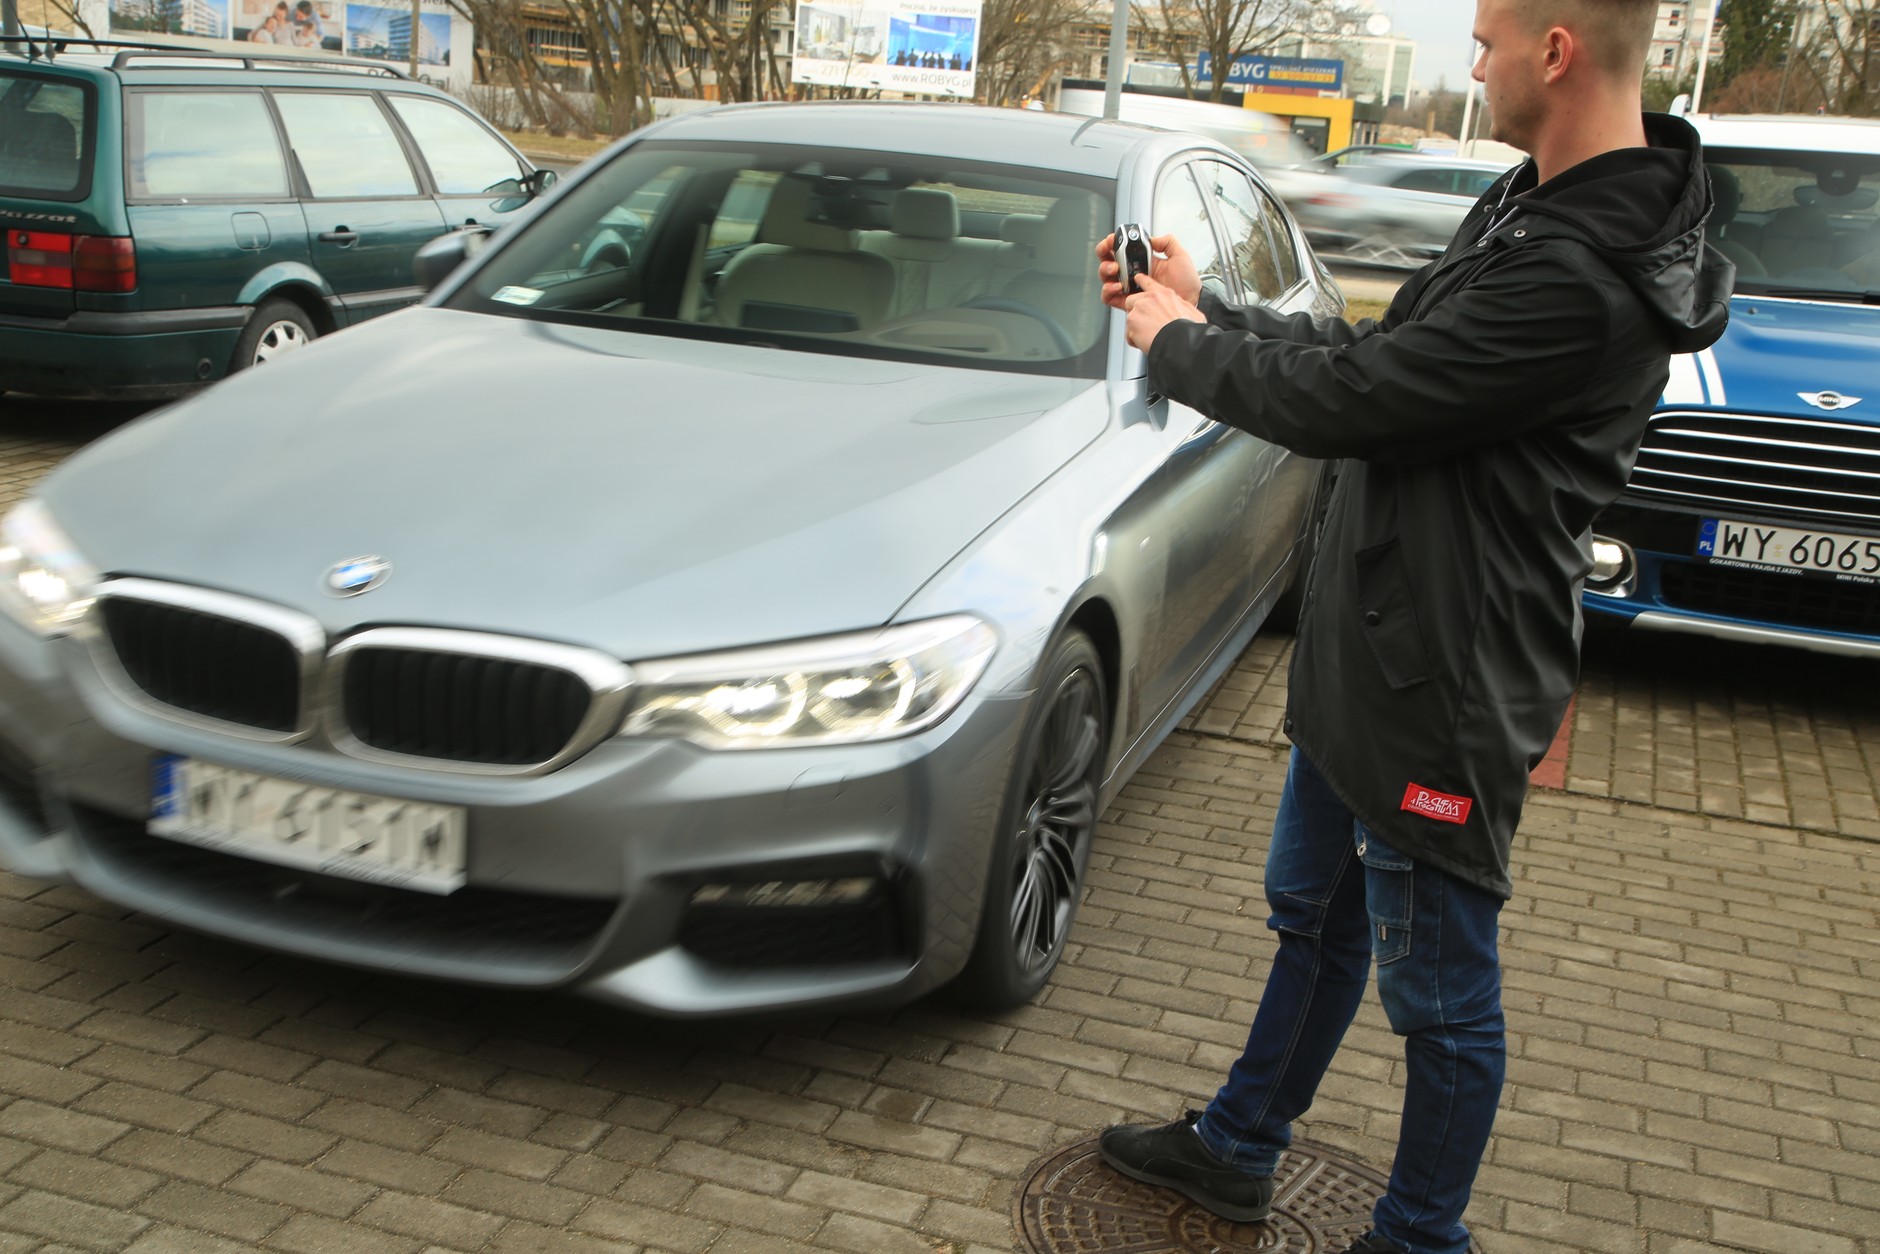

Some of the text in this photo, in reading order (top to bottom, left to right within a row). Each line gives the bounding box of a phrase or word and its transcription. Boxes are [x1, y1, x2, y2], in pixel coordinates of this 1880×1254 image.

[1202, 60, 1265, 79] RBYG
[892, 73, 971, 88] www.ROBYG.pl
[1699, 541, 1712, 551] PL
[1722, 525, 1880, 573] WY 6065
[1709, 557, 1750, 569] GOKARTOWA
[1751, 563, 1775, 572] FRAJDA
[1836, 573, 1875, 584] MINI Polska
